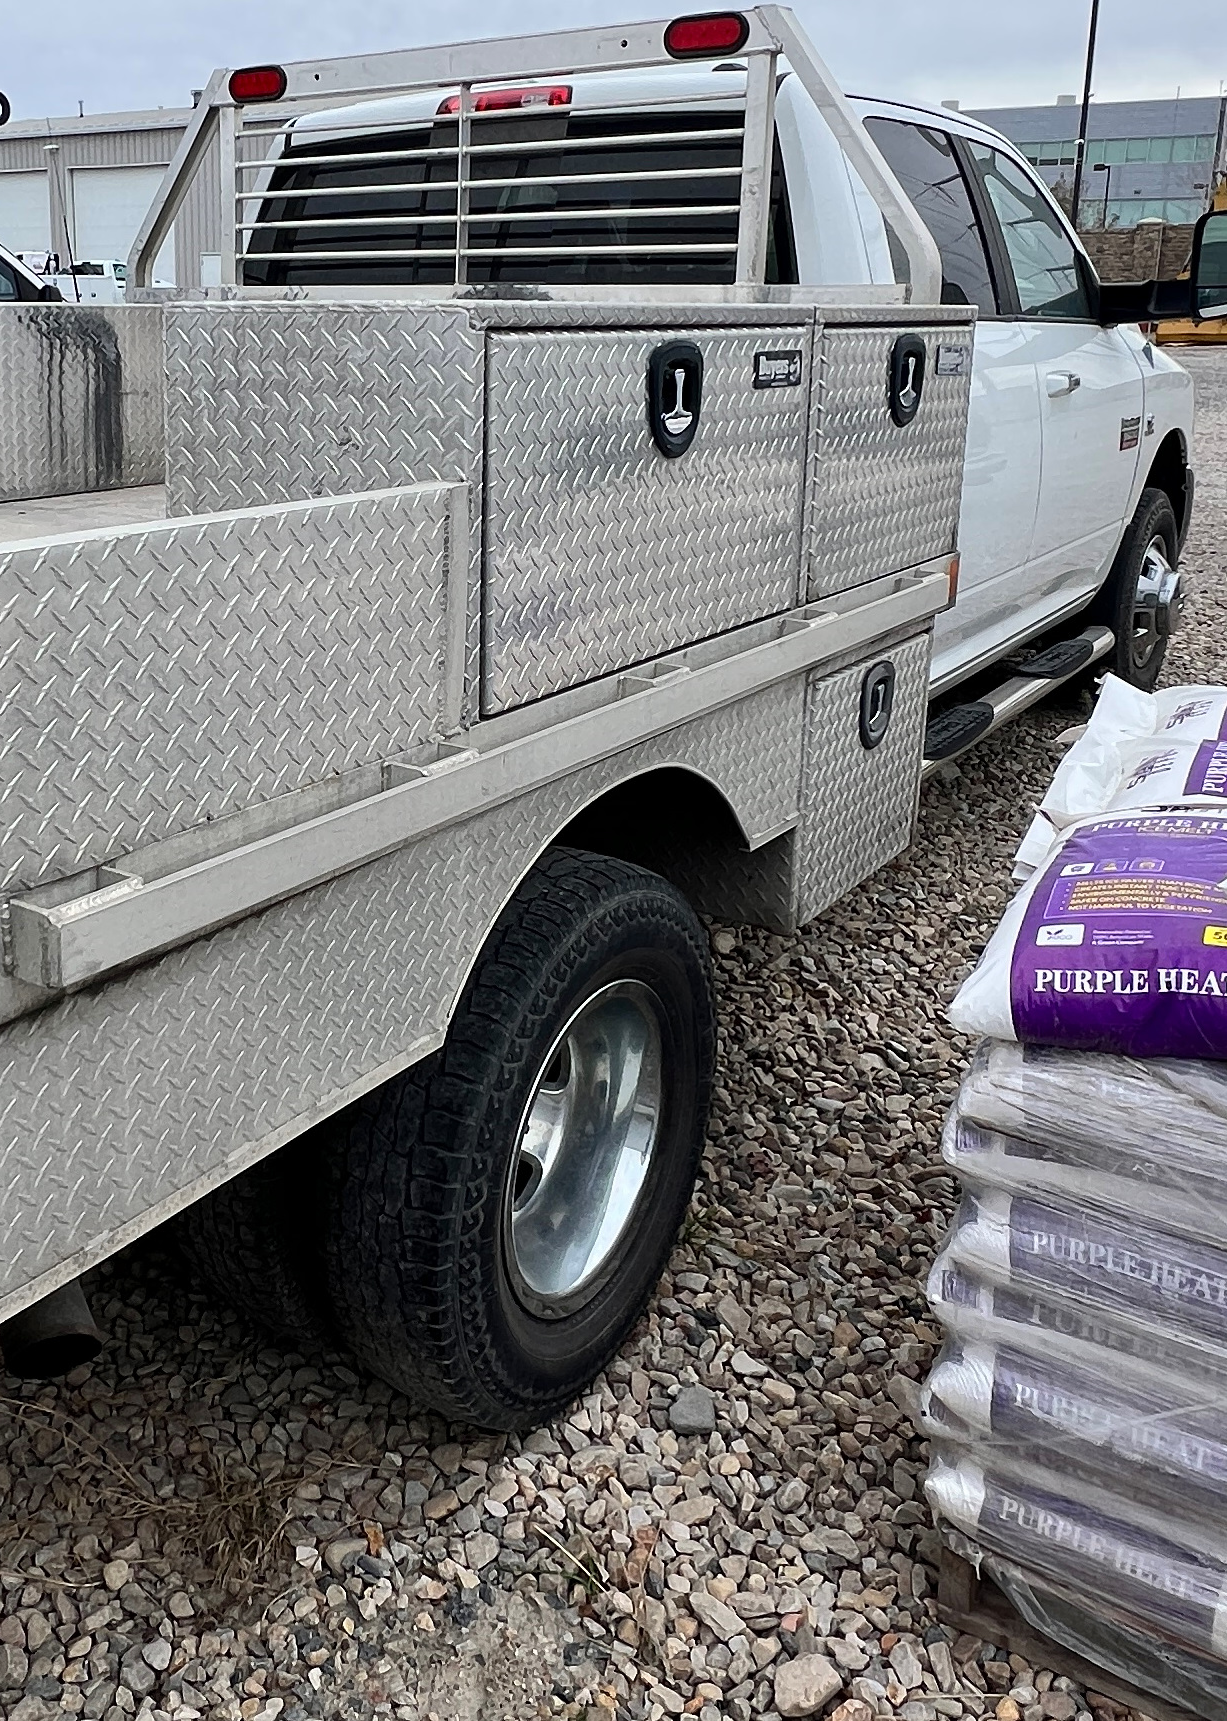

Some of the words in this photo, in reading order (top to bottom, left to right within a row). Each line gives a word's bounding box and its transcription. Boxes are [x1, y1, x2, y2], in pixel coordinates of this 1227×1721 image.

[1092, 819, 1192, 832] PURPLE
[1034, 968, 1149, 994] PURPLE
[1157, 968, 1227, 997] HEA
[1032, 1230, 1146, 1277] PURPLE
[998, 1496, 1108, 1561] PURPLE
